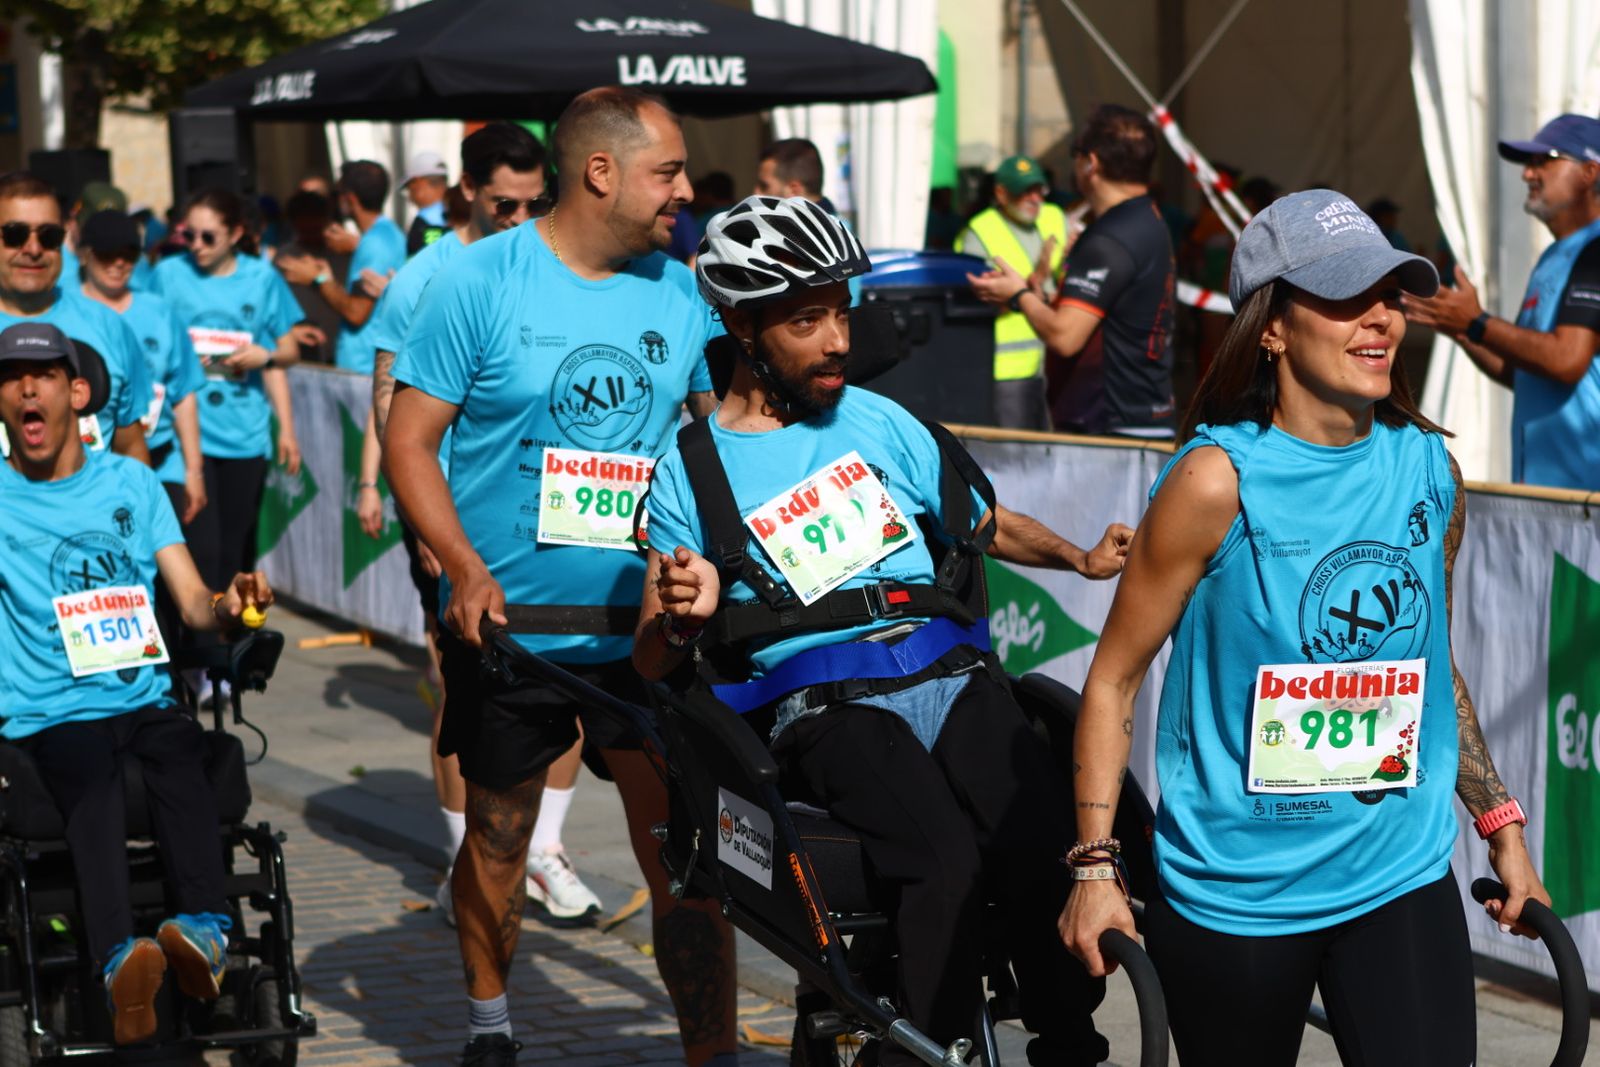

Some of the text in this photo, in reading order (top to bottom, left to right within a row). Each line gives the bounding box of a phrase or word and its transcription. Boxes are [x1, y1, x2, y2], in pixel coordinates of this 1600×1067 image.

[562, 349, 643, 377] CROSS VILLAMAYOR ASPACE
[572, 376, 625, 414] XII
[575, 486, 635, 519] 980
[1270, 547, 1312, 559] Villamayor
[1302, 538, 1311, 546] de
[1311, 566, 1333, 597] CROSS
[1330, 548, 1384, 572] VILLAMAYOR
[57, 592, 146, 619] bedunia
[1328, 579, 1401, 646] XII
[83, 615, 144, 647] 1501
[1259, 667, 1420, 701] bedunia
[1300, 709, 1379, 750] 981
[1275, 799, 1333, 813] SUMESAL
[734, 815, 772, 853] DIPUTACIÓN
